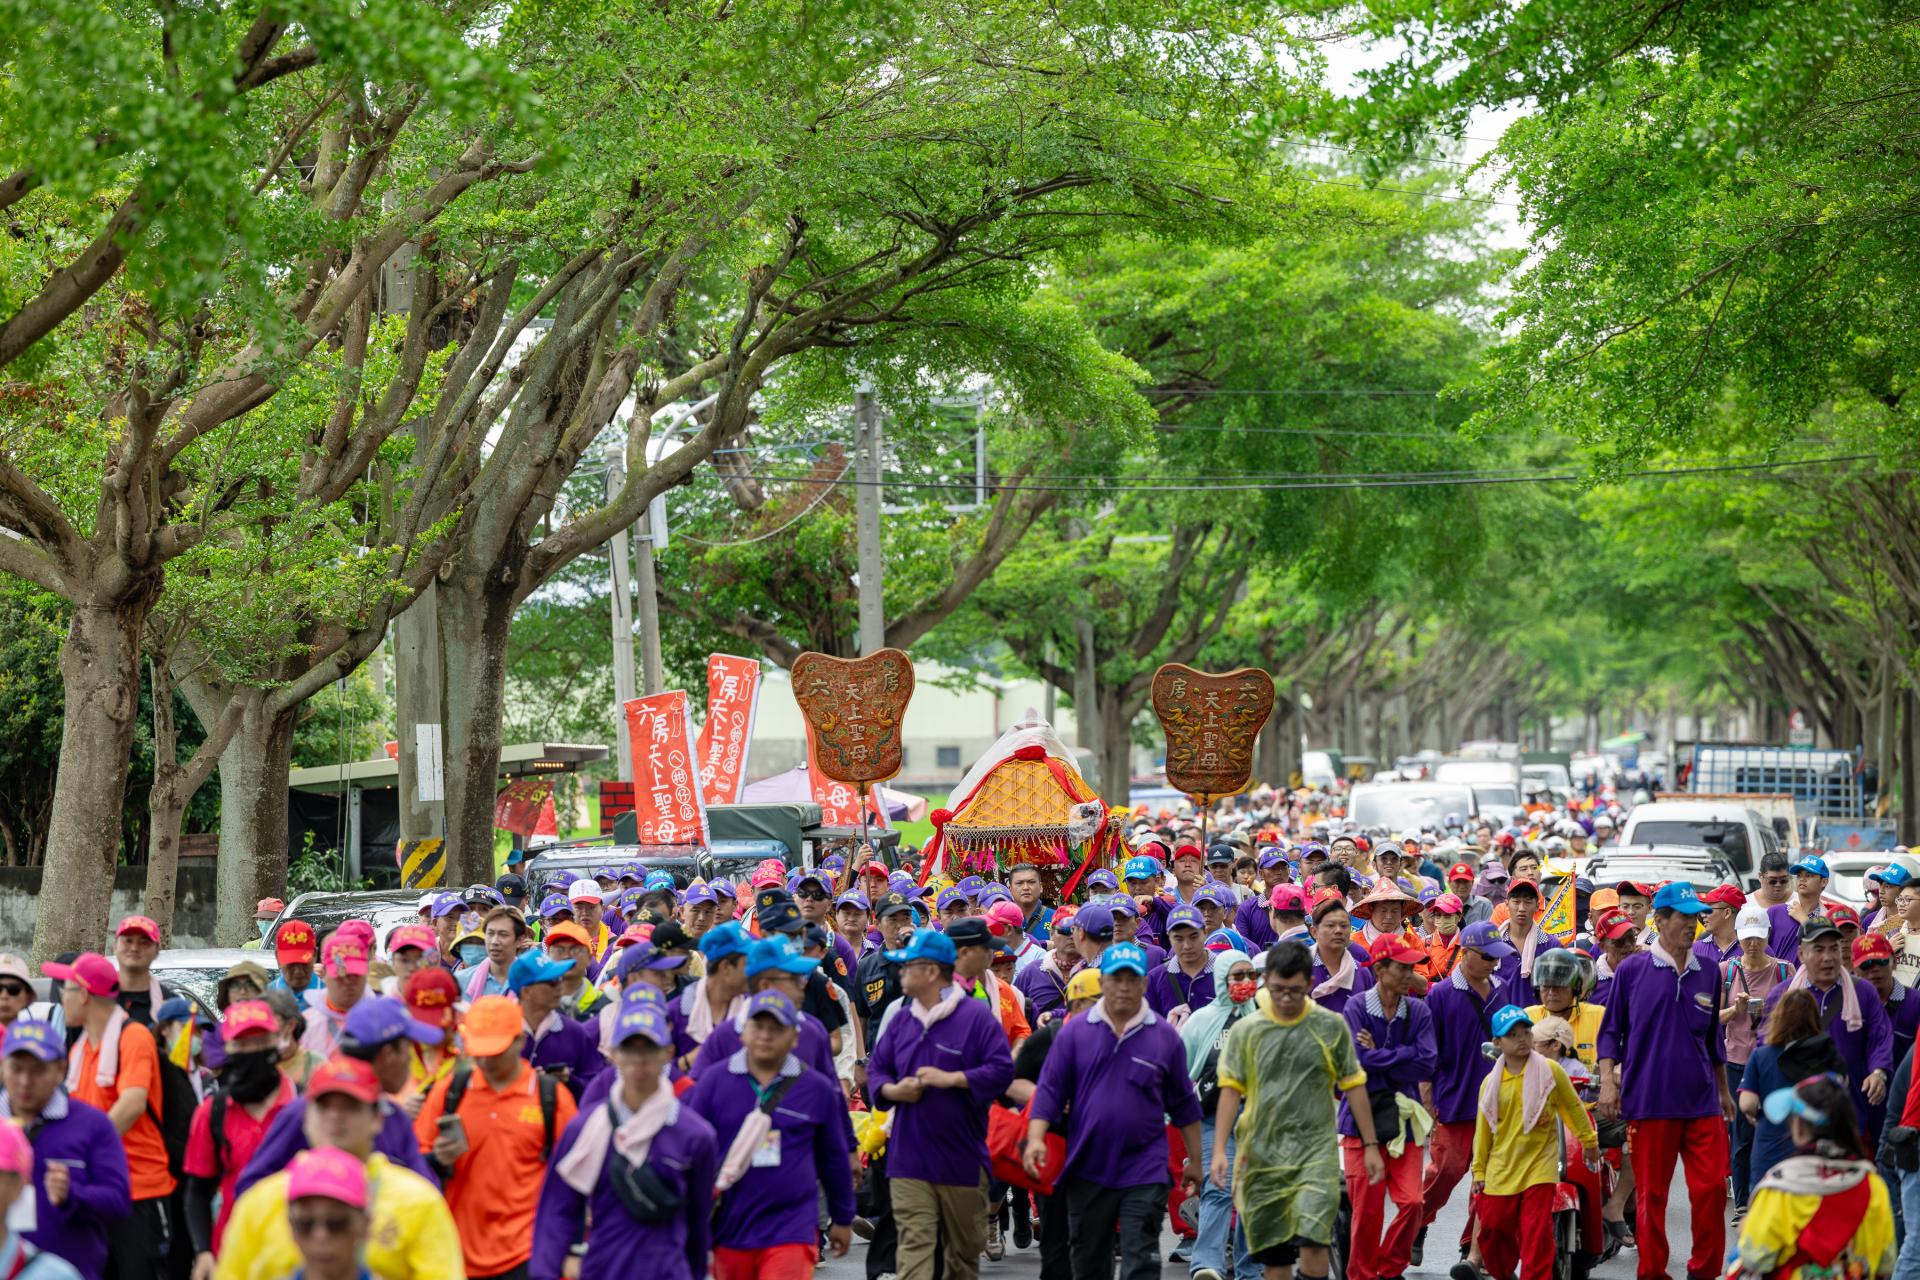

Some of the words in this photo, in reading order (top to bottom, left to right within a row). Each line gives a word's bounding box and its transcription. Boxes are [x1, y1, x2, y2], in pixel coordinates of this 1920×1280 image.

[700, 660, 740, 789] 六房天上聖母
[810, 678, 831, 697] 六
[845, 683, 869, 763] 天上聖母
[1238, 682, 1259, 700] 六
[1200, 691, 1222, 770] 天上聖母
[636, 703, 679, 845] 六房天上聖母
